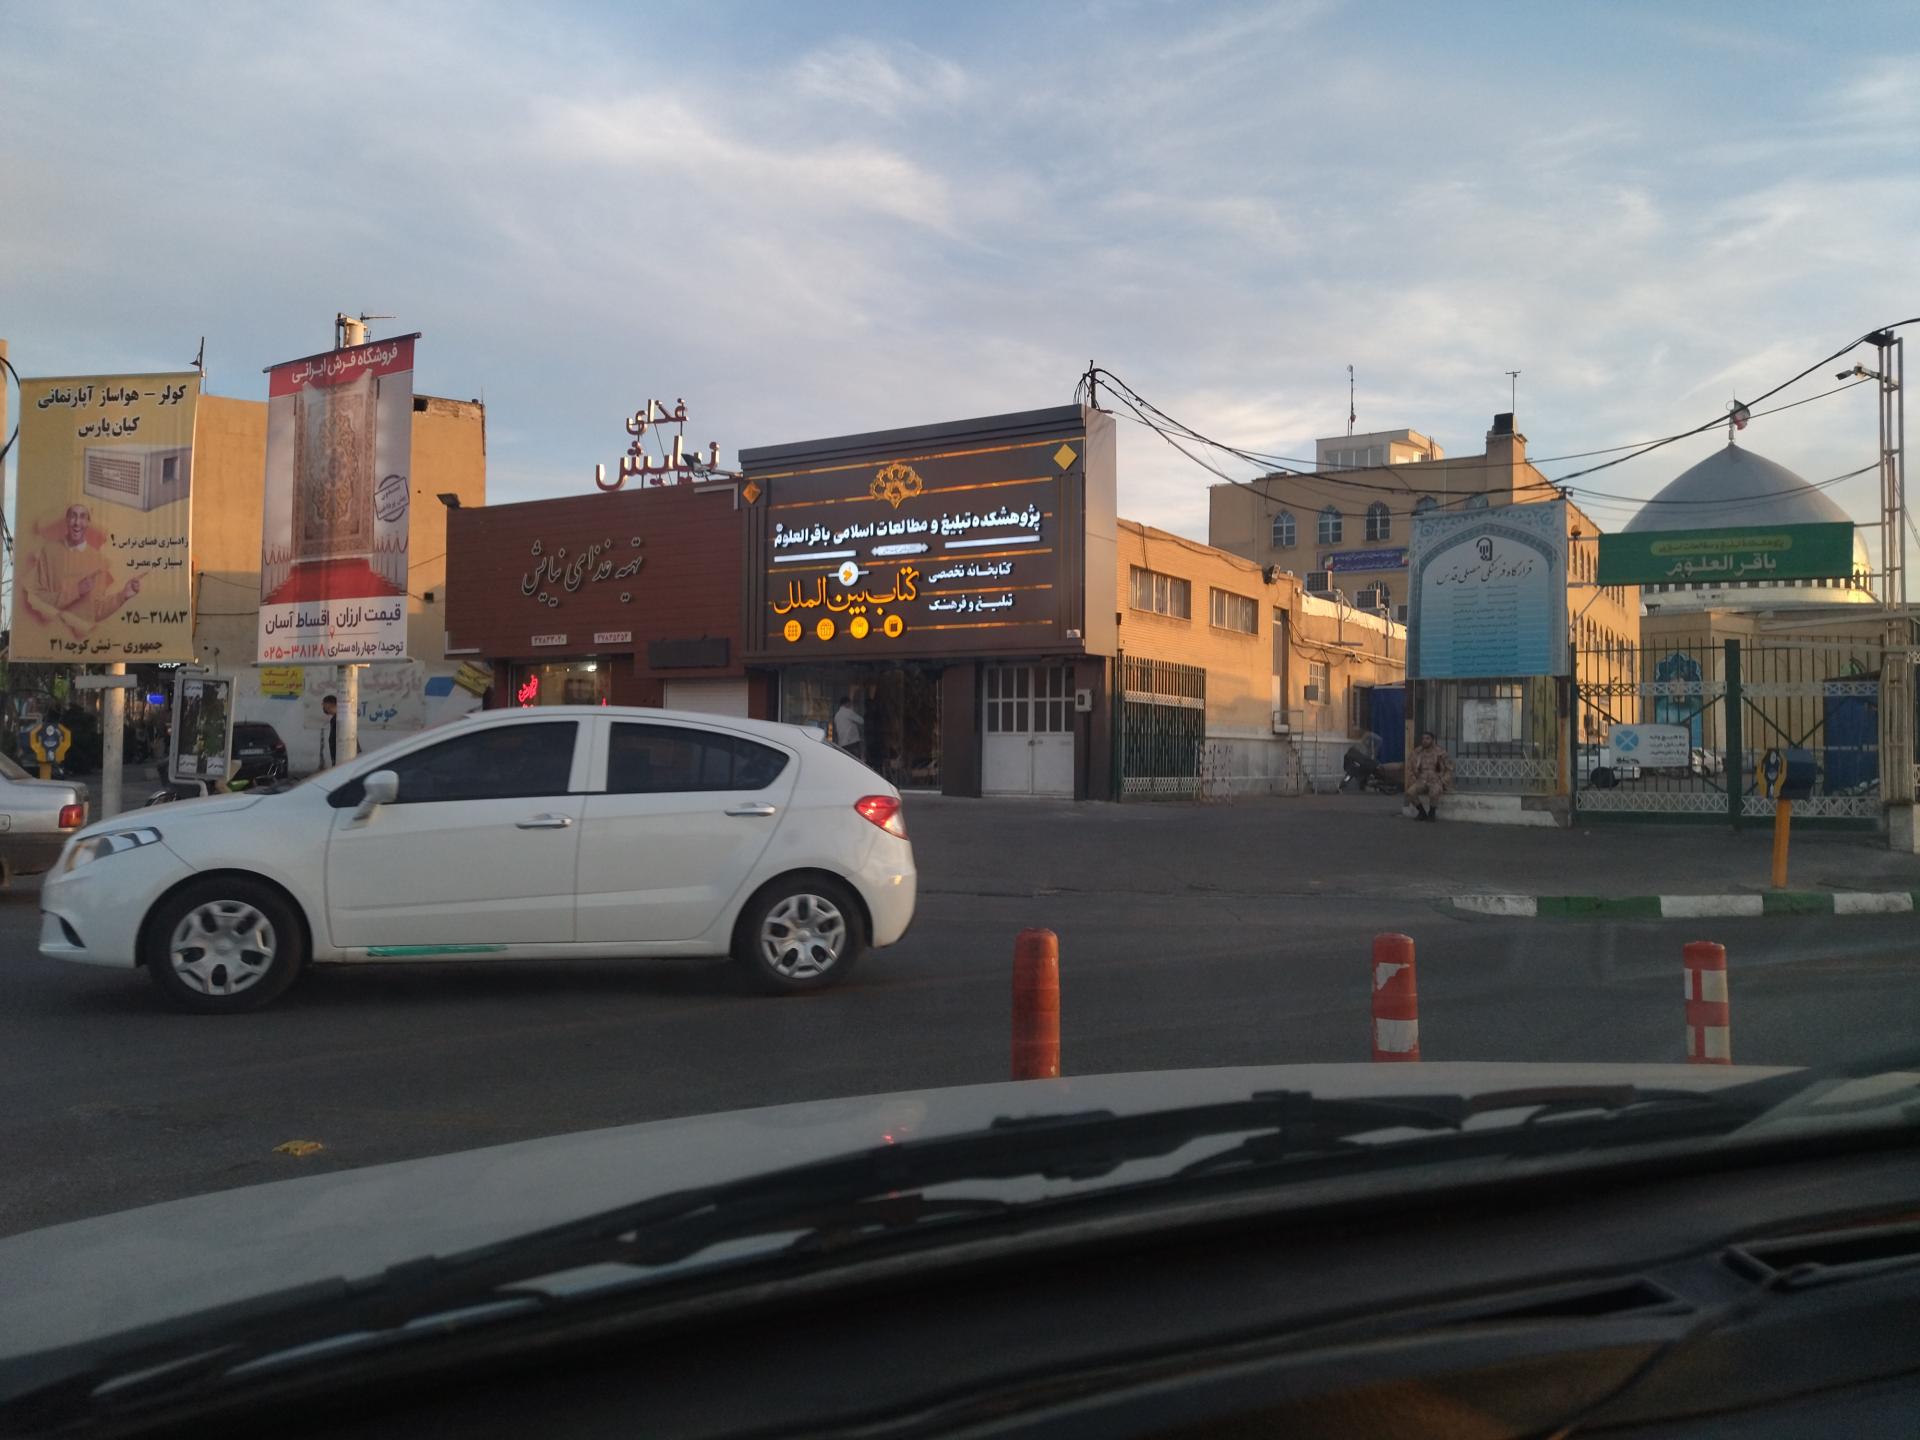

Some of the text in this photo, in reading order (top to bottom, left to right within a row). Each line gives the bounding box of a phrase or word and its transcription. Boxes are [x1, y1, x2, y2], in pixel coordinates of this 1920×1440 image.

[291, 342, 398, 384] فروشگاه فرش ایرانی
[38, 385, 94, 408] آپارتمانی
[99, 386, 139, 407] هواساز
[159, 384, 187, 405] کولر
[78, 416, 140, 437] کیان پارس
[626, 398, 690, 435] غذای
[876, 518, 928, 536] مطالعات
[930, 518, 939, 534] و
[940, 512, 971, 535] تبلیغ
[971, 504, 1040, 532] پژوهشکده
[833, 522, 874, 545] اسلامی
[564, 538, 612, 591] غذای
[614, 536, 643, 603] تهیه
[928, 561, 1012, 583] کتابخانه تخصصی
[1665, 552, 1777, 578] باقر العلوم
[773, 566, 920, 616] کتاب بین الملل
[968, 600, 974, 612] و
[975, 593, 1013, 612] تبلیغ
[265, 604, 401, 635] قیمت ارزان اقساط آسان
[50, 638, 62, 651] ۳۱
[65, 639, 89, 655] کوچه
[91, 638, 111, 654] نبش
[123, 640, 162, 654] جمهوری
[327, 643, 351, 657] ستاری
[369, 703, 398, 722] خوش
